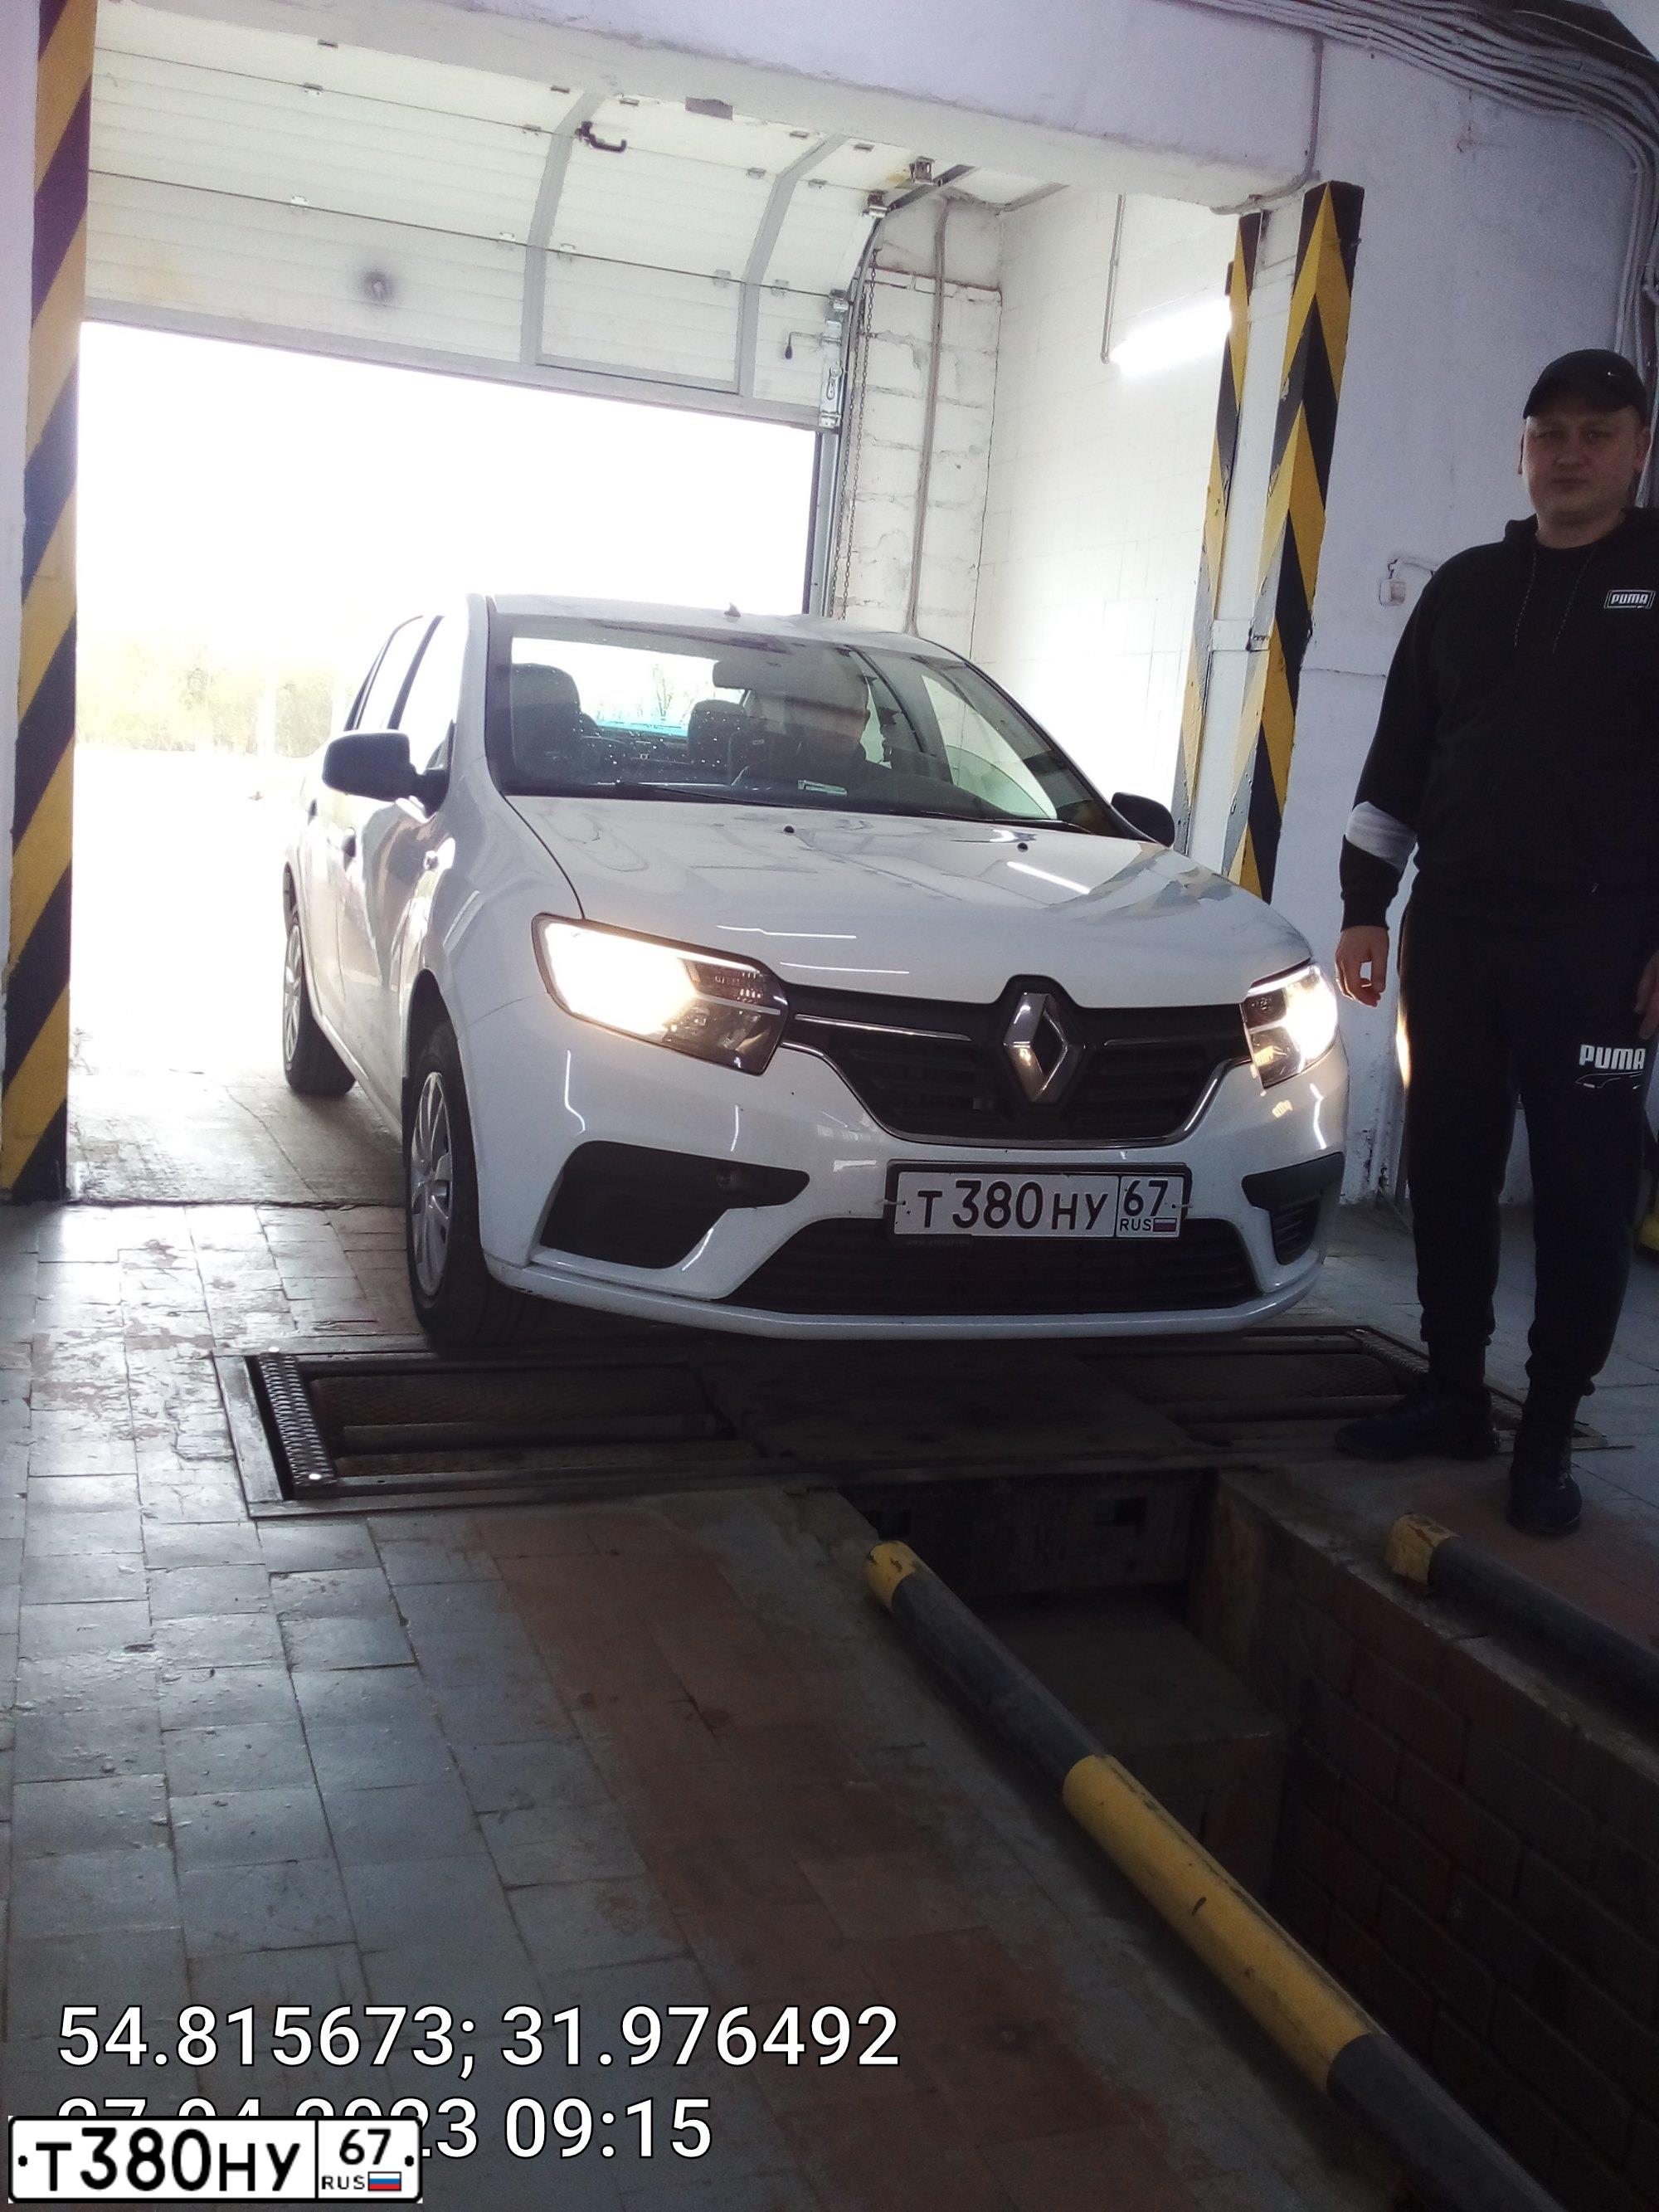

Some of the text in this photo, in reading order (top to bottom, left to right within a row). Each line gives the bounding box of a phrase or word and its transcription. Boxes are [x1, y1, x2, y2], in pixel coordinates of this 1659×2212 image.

[1610, 593, 1649, 605] PUMA
[1579, 1044, 1646, 1070] PUMA
[1123, 1179, 1169, 1217] 67
[1119, 1218, 1152, 1231] RUS
